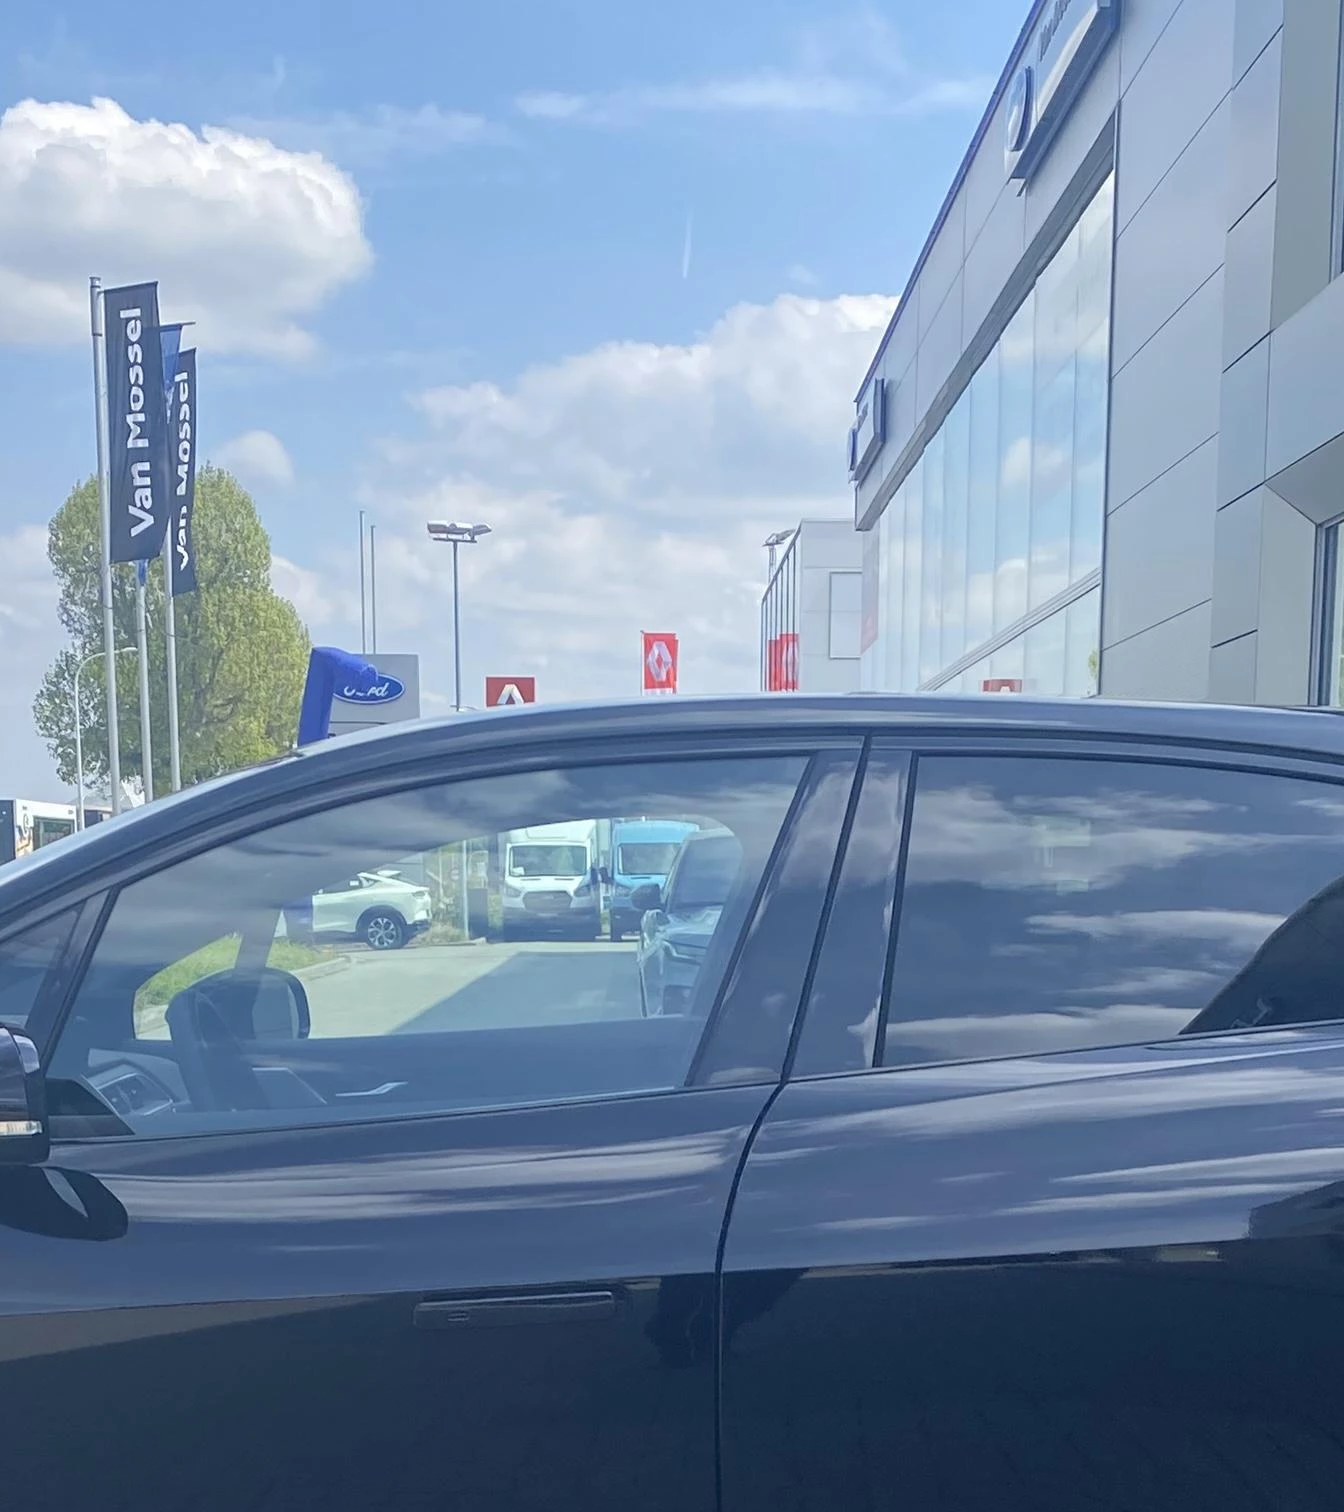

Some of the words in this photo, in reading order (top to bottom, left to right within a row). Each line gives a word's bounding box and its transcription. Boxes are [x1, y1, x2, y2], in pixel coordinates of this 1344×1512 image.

[119, 308, 149, 449] Mossel
[174, 371, 192, 496] Mossel
[128, 461, 155, 537] Van
